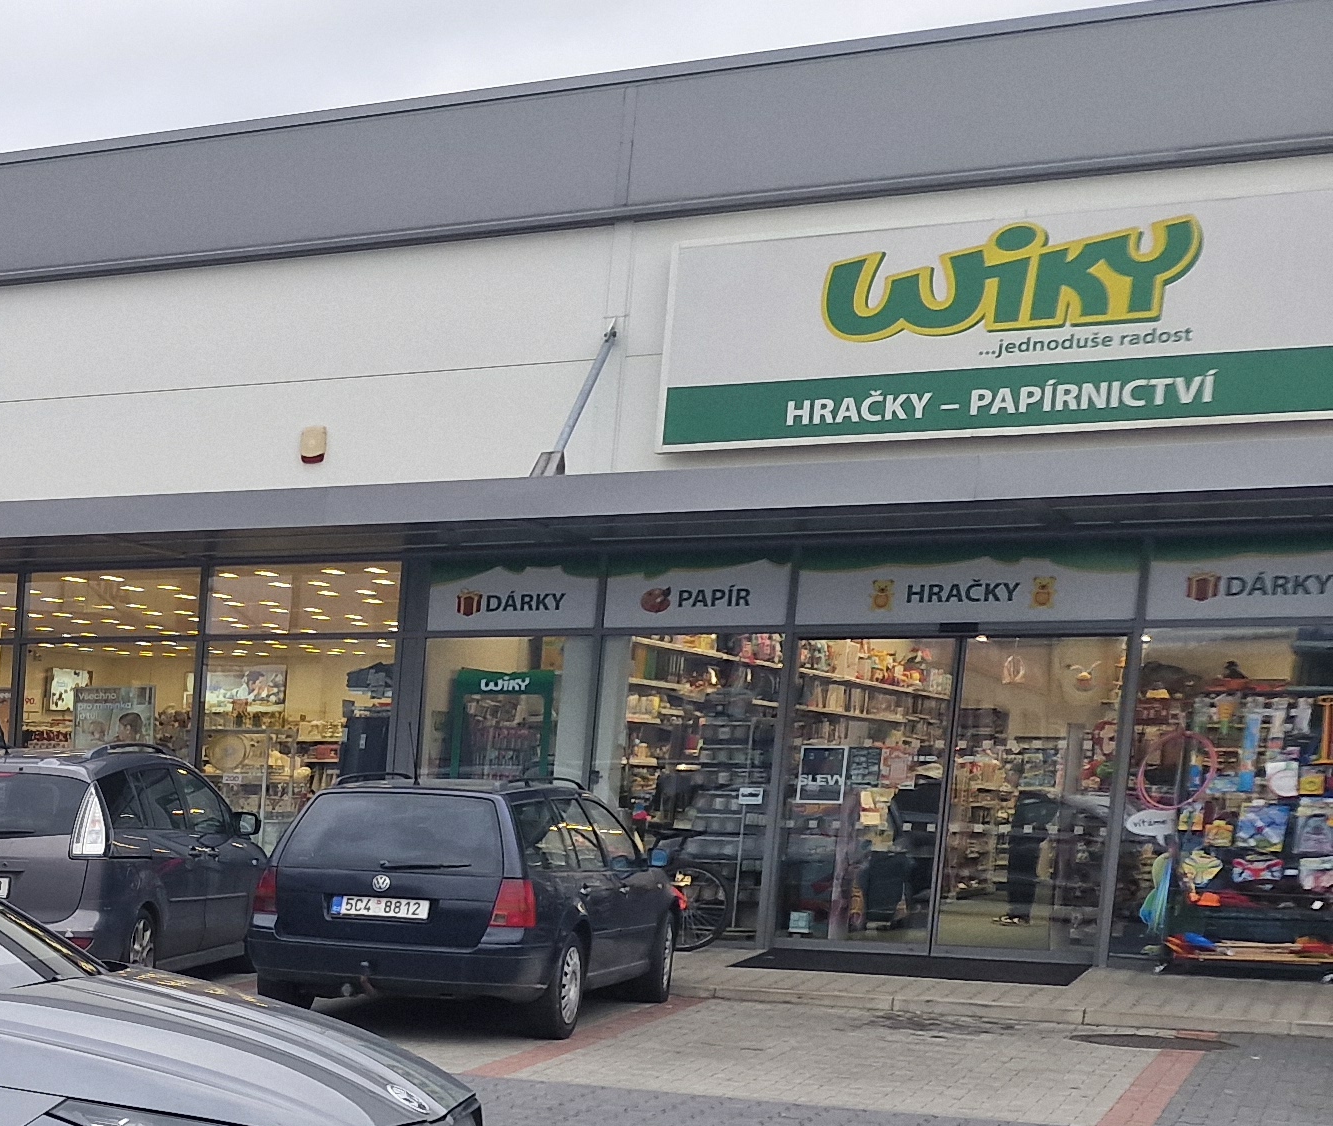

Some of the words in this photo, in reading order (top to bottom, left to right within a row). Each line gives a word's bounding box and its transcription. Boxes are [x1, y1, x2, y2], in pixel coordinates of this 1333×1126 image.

[1121, 327, 1193, 348] radost
[785, 391, 933, 426] HRAČKY
[969, 369, 1218, 416] PAPÍRNICTVÍ
[677, 583, 751, 608] PAPÍR
[906, 578, 1021, 604] HRAČKY
[1223, 572, 1332, 598] DÁRKY
[485, 589, 566, 613] DÁRKY
[798, 774, 844, 786] SLEVY
[345, 897, 371, 912] 5C4
[383, 900, 421, 916] 8812
